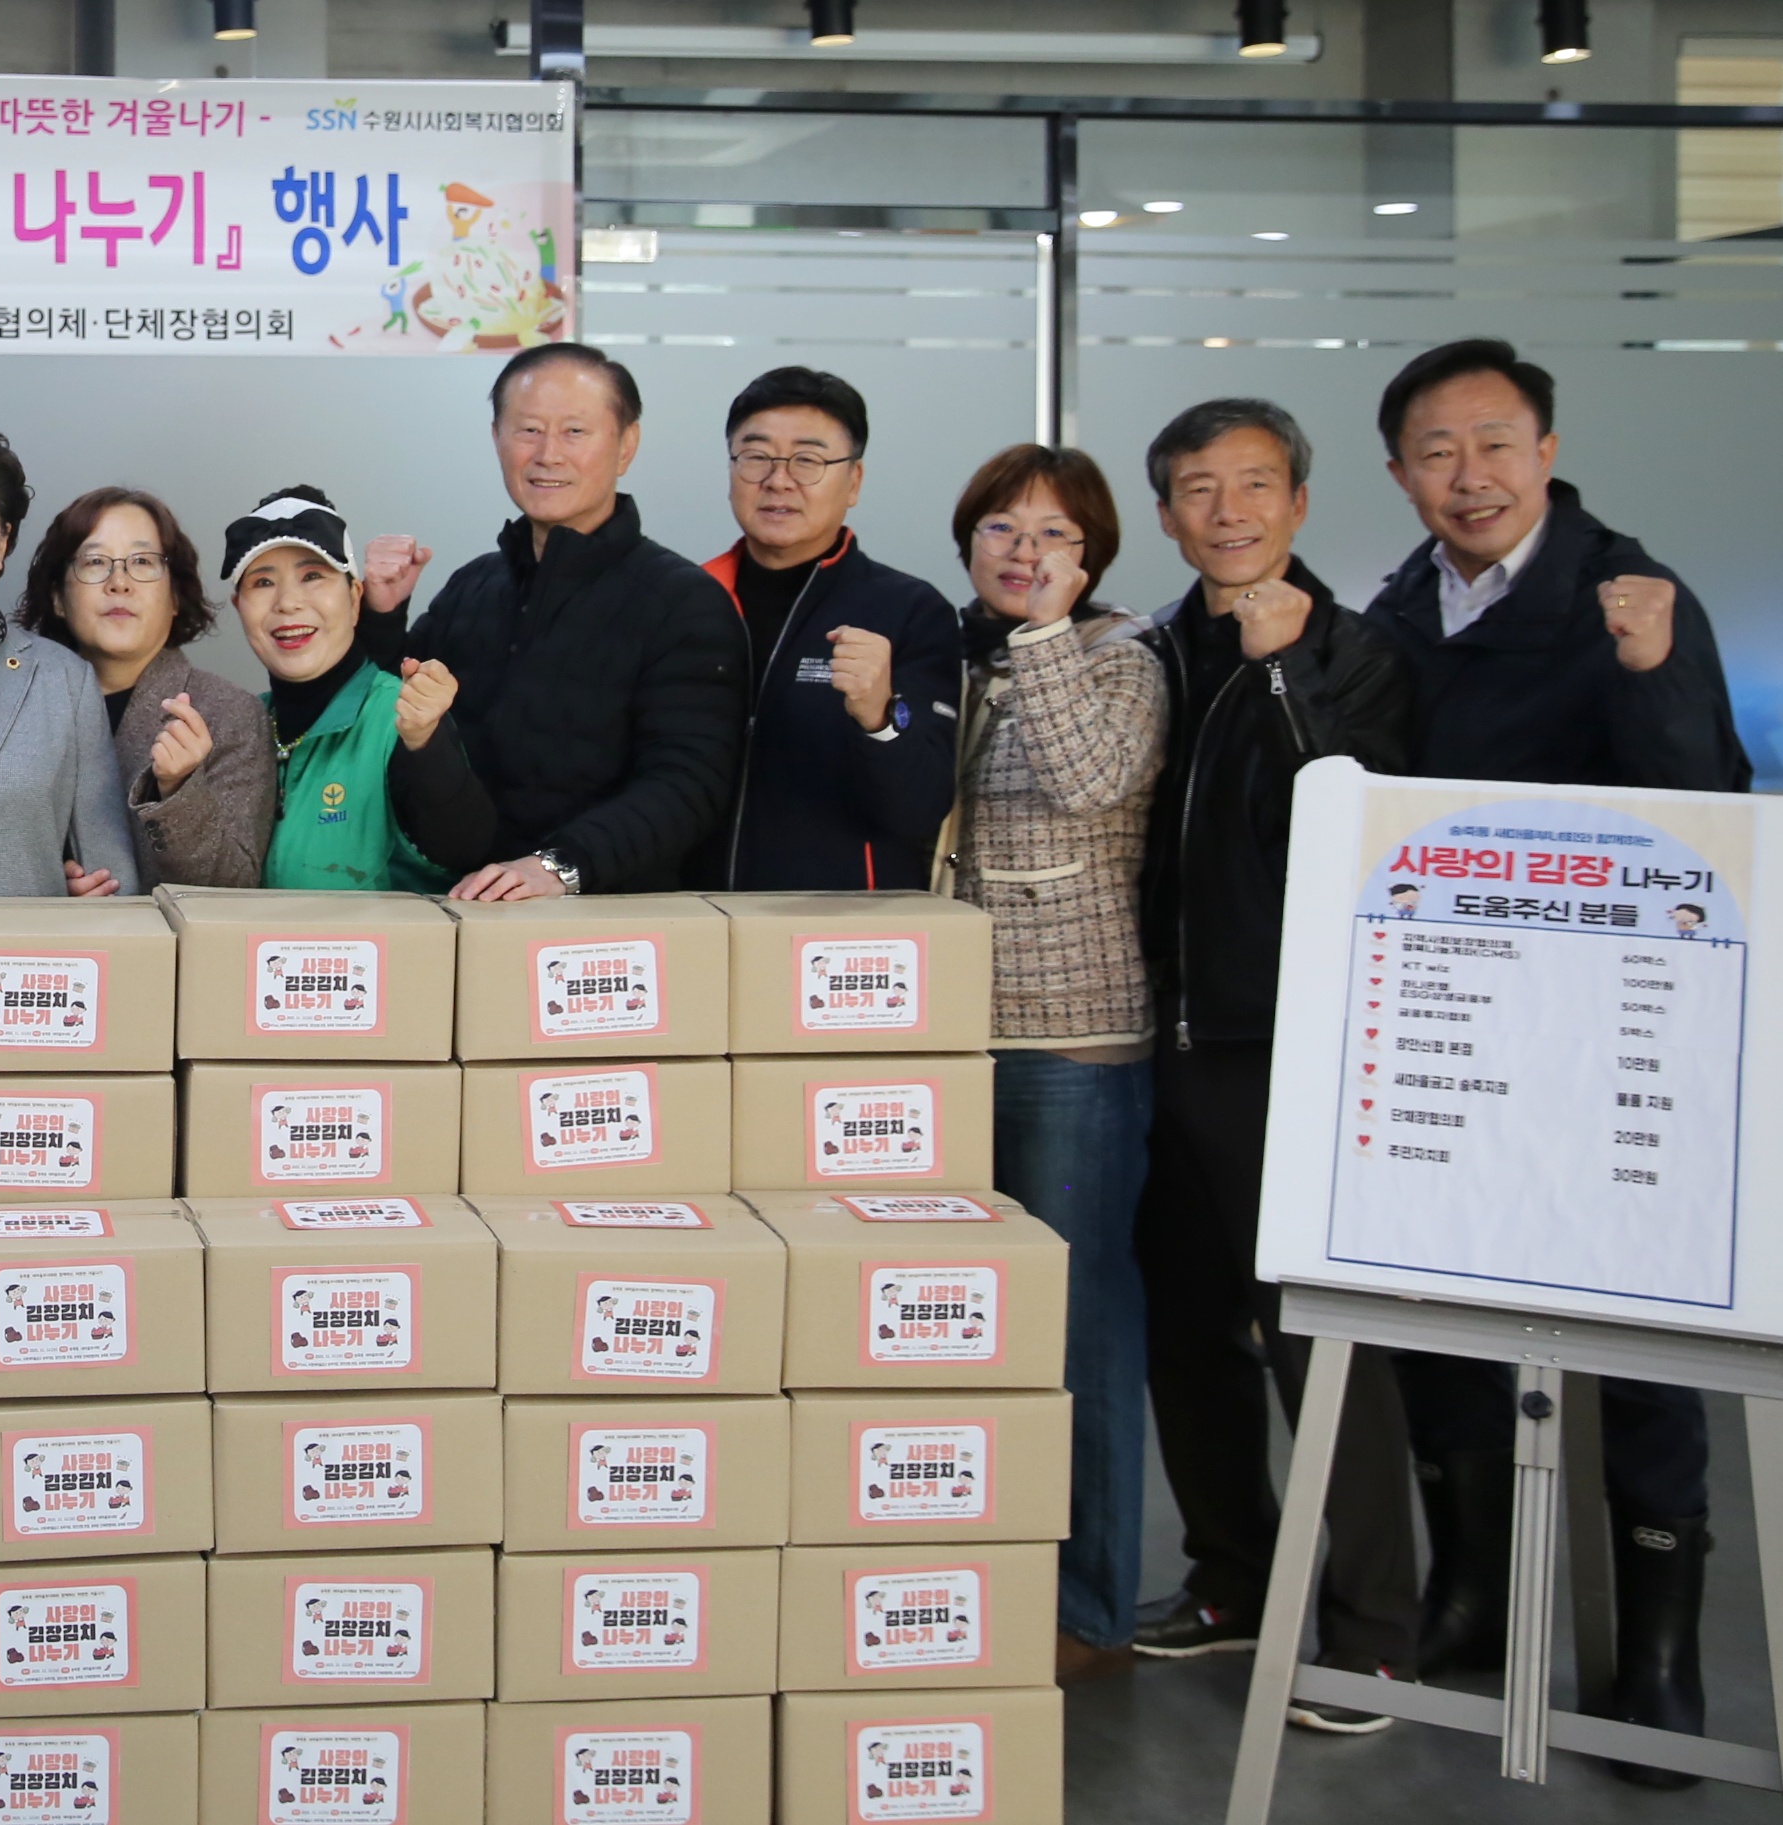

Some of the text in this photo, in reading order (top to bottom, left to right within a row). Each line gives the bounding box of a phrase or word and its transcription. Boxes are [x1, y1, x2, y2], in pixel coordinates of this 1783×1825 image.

[107, 99, 245, 137] 겨울나기
[307, 109, 357, 130] SSN
[364, 109, 564, 132] 수원시사회복지협의회
[272, 166, 409, 276] 행사
[1390, 846, 1713, 893] 사랑의 김장 나누기
[1453, 895, 1639, 927] 도움주신 분들
[581, 959, 627, 976] 사랑의
[844, 957, 889, 972] 사랑의
[21, 974, 68, 990] 사랑의
[567, 976, 628, 995] 김장김치
[829, 974, 889, 990] 김장김치
[4, 991, 67, 1007] 김장김치
[568, 995, 614, 1013] 나누기
[830, 992, 874, 1008] 나누기
[4, 1009, 51, 1024] 나누기
[1617, 1056, 1660, 1073] 10만원
[574, 1090, 620, 1107] 사랑의
[306, 1107, 352, 1122] 사랑의
[560, 1107, 621, 1127] 김장김치
[290, 1124, 352, 1141] 김장김치
[561, 1126, 607, 1145] 나누기
[1614, 1130, 1660, 1148] 20만원
[290, 1142, 337, 1158] 나누기
[1612, 1168, 1658, 1186] 30만원
[43, 1284, 94, 1301] 사랑의
[917, 1285, 966, 1301] 사랑의
[27, 1303, 94, 1322] 김장김치
[633, 1301, 683, 1318] 사랑의
[900, 1304, 965, 1320] 김장김치
[27, 1322, 78, 1341] 나누기
[615, 1318, 681, 1336] 김장김치
[900, 1322, 949, 1338] 나누기
[614, 1337, 663, 1354] 나누기
[342, 1444, 391, 1460] 사랑의
[907, 1444, 955, 1460] 사랑의
[62, 1453, 112, 1470] 사랑의
[325, 1462, 391, 1480] 김장김치
[890, 1462, 954, 1479] 김장김치
[45, 1472, 112, 1491] 김장김치
[325, 1481, 374, 1499] 나누기
[890, 1480, 938, 1498] 나누기
[45, 1491, 95, 1510] 나누기
[620, 1591, 668, 1607] 사랑의
[45, 1605, 96, 1622] 사랑의
[603, 1610, 667, 1626] 김장김치
[29, 1624, 96, 1643] 김장김치
[603, 1628, 651, 1645] 나누기
[29, 1643, 80, 1662] 나누기
[318, 1750, 368, 1766] 사랑의
[612, 1750, 660, 1766] 사랑의
[904, 1742, 952, 1758] 사랑의
[28, 1754, 78, 1770] 사랑의
[888, 1760, 952, 1778] 김장김치
[10, 1773, 77, 1790] 김장김치
[301, 1768, 366, 1785] 김장김치
[595, 1768, 660, 1785] 김장김치
[301, 1786, 350, 1803] 나누기
[595, 1787, 644, 1804] 나누기
[888, 1779, 936, 1797] 나누기
[11, 1791, 61, 1809] 나누기
